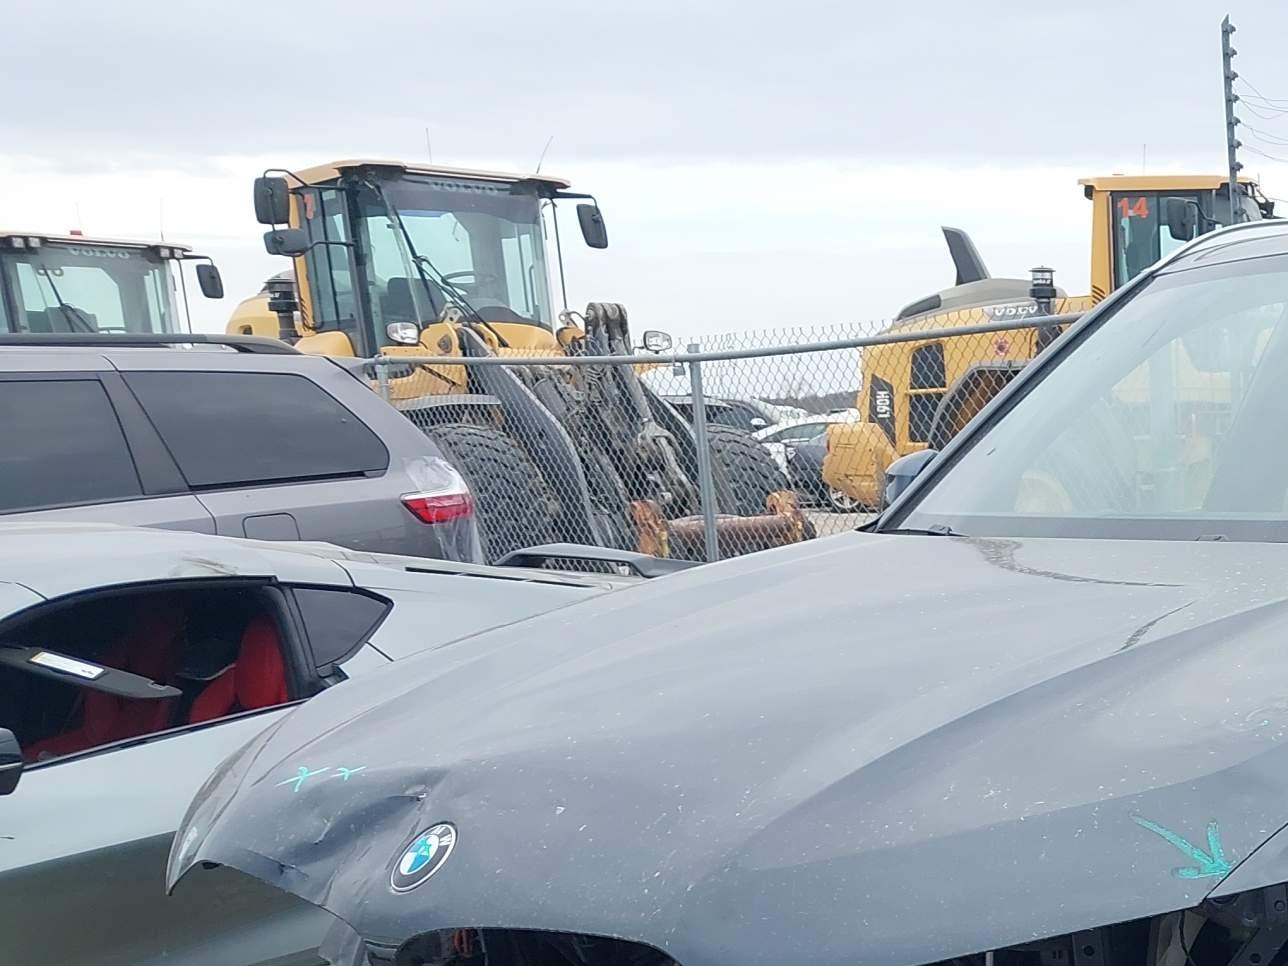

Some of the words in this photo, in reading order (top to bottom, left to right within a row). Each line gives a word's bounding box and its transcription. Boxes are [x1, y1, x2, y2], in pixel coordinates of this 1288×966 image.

[1118, 196, 1149, 218] 14
[994, 305, 1039, 317] VOLV
[875, 390, 891, 419] L90H
